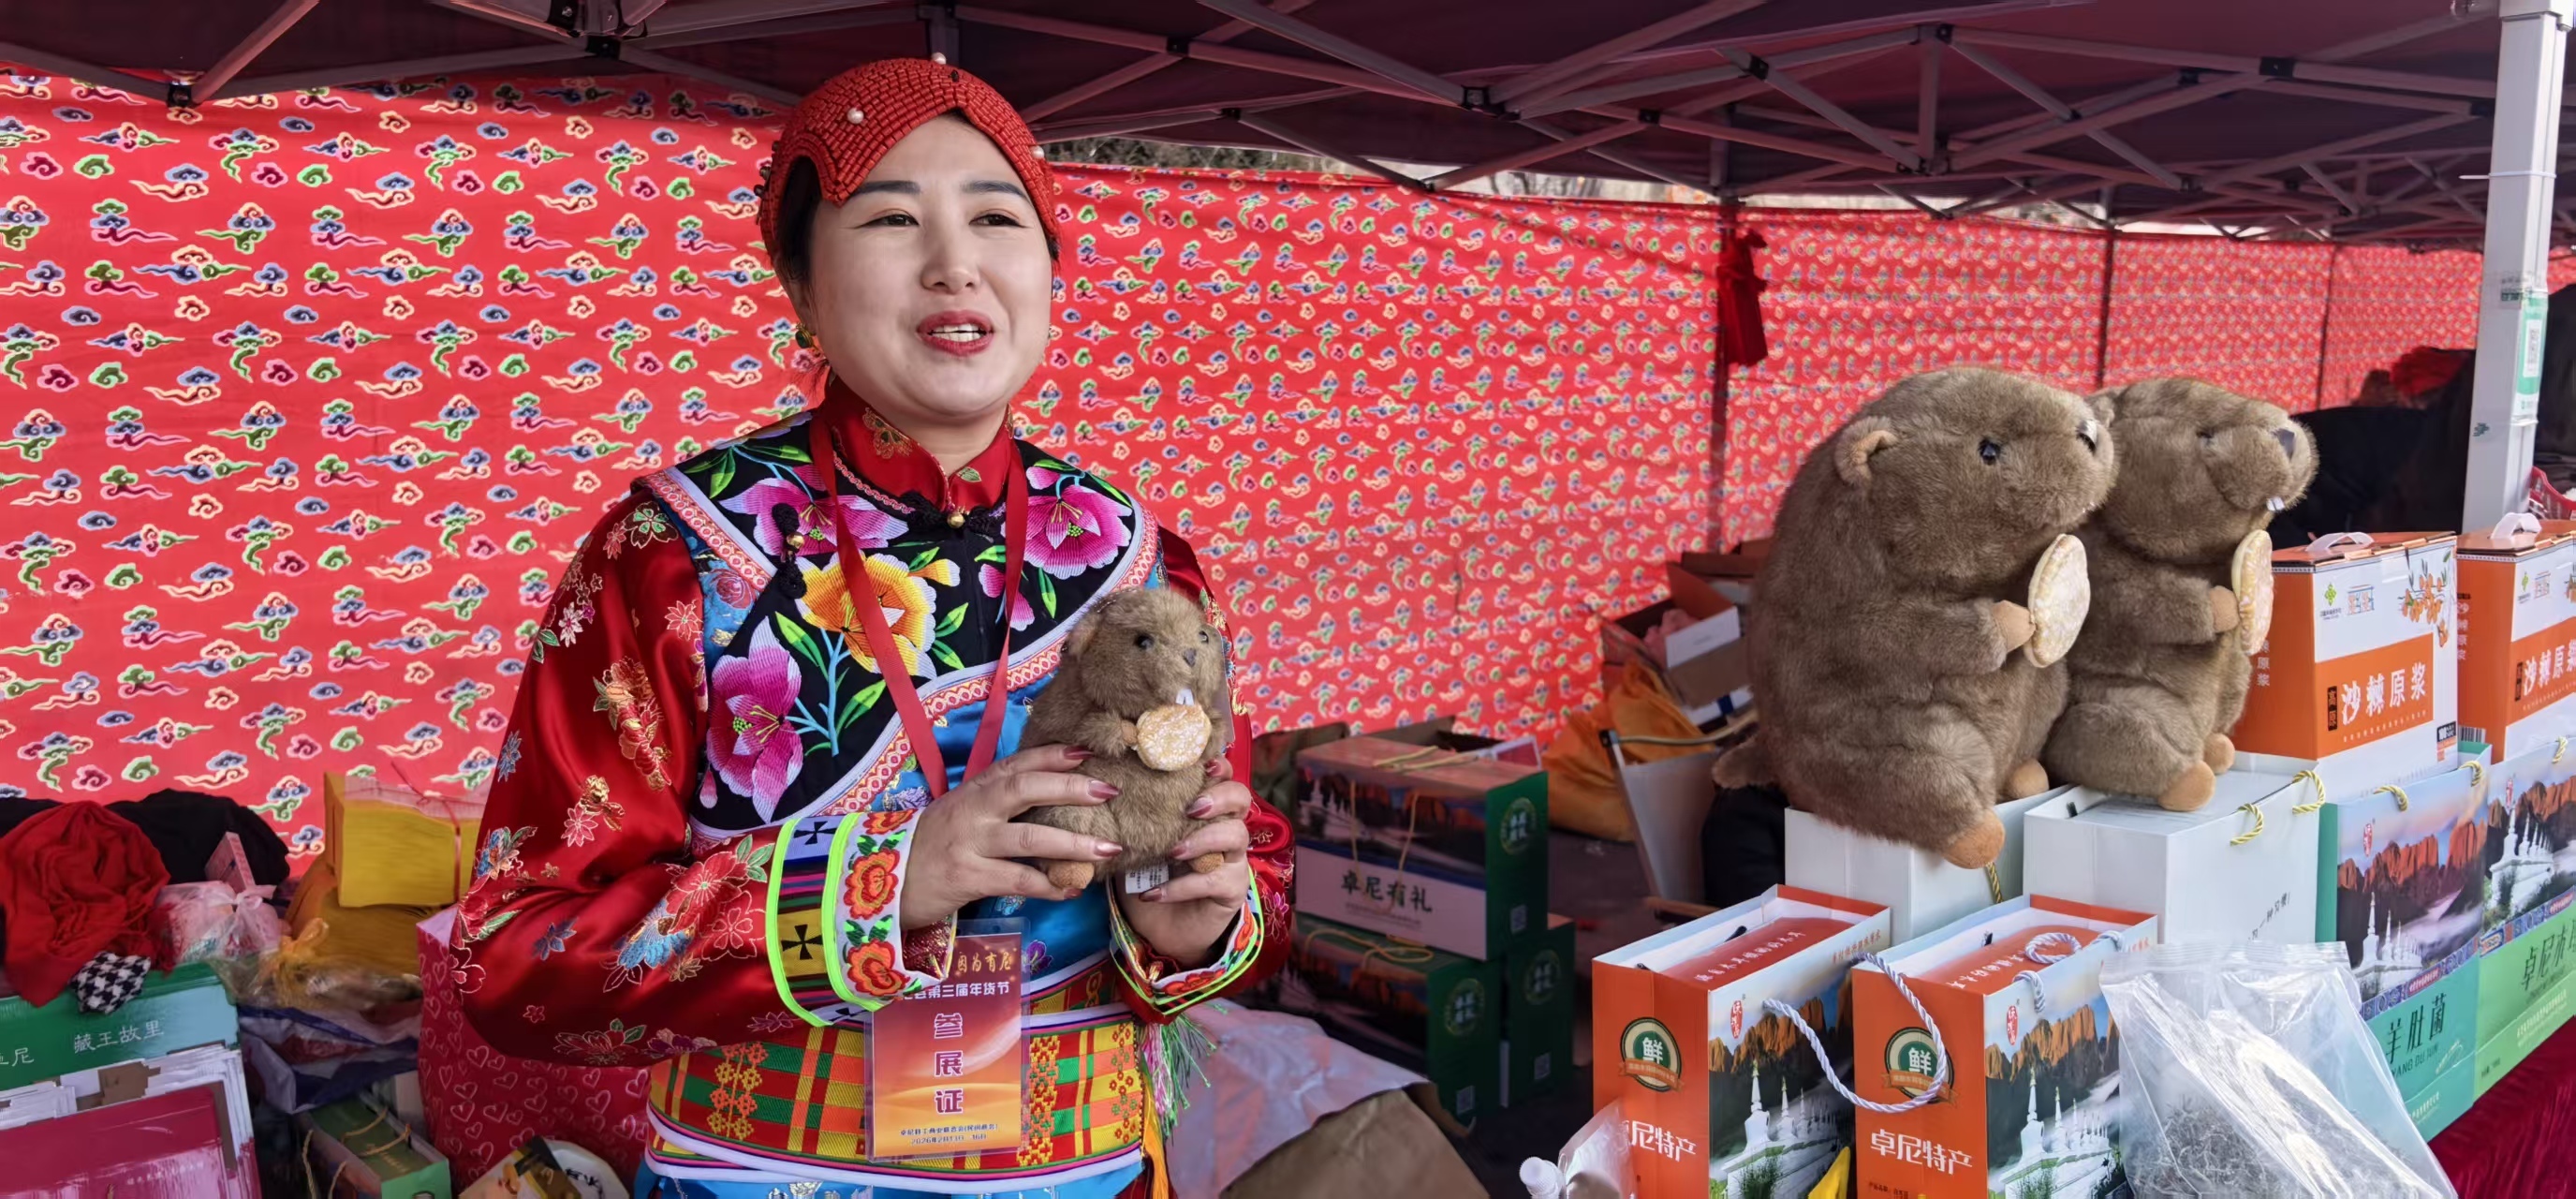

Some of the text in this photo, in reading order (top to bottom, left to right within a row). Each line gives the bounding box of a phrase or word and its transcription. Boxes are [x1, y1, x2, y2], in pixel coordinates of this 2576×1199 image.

[2341, 661, 2426, 726] 沙棘原浆
[1341, 869, 1432, 912] 卓尼有礼
[74, 1020, 164, 1054] 藏王故里
[1641, 1036, 1664, 1063] 鲜
[2386, 993, 2447, 1064] 羊肚菌
[935, 1013, 963, 1115] 参展证
[1907, 1047, 1932, 1074] 鲜
[1622, 1119, 1697, 1162] 尼特产
[1871, 1128, 1973, 1176] 卓尼特产
